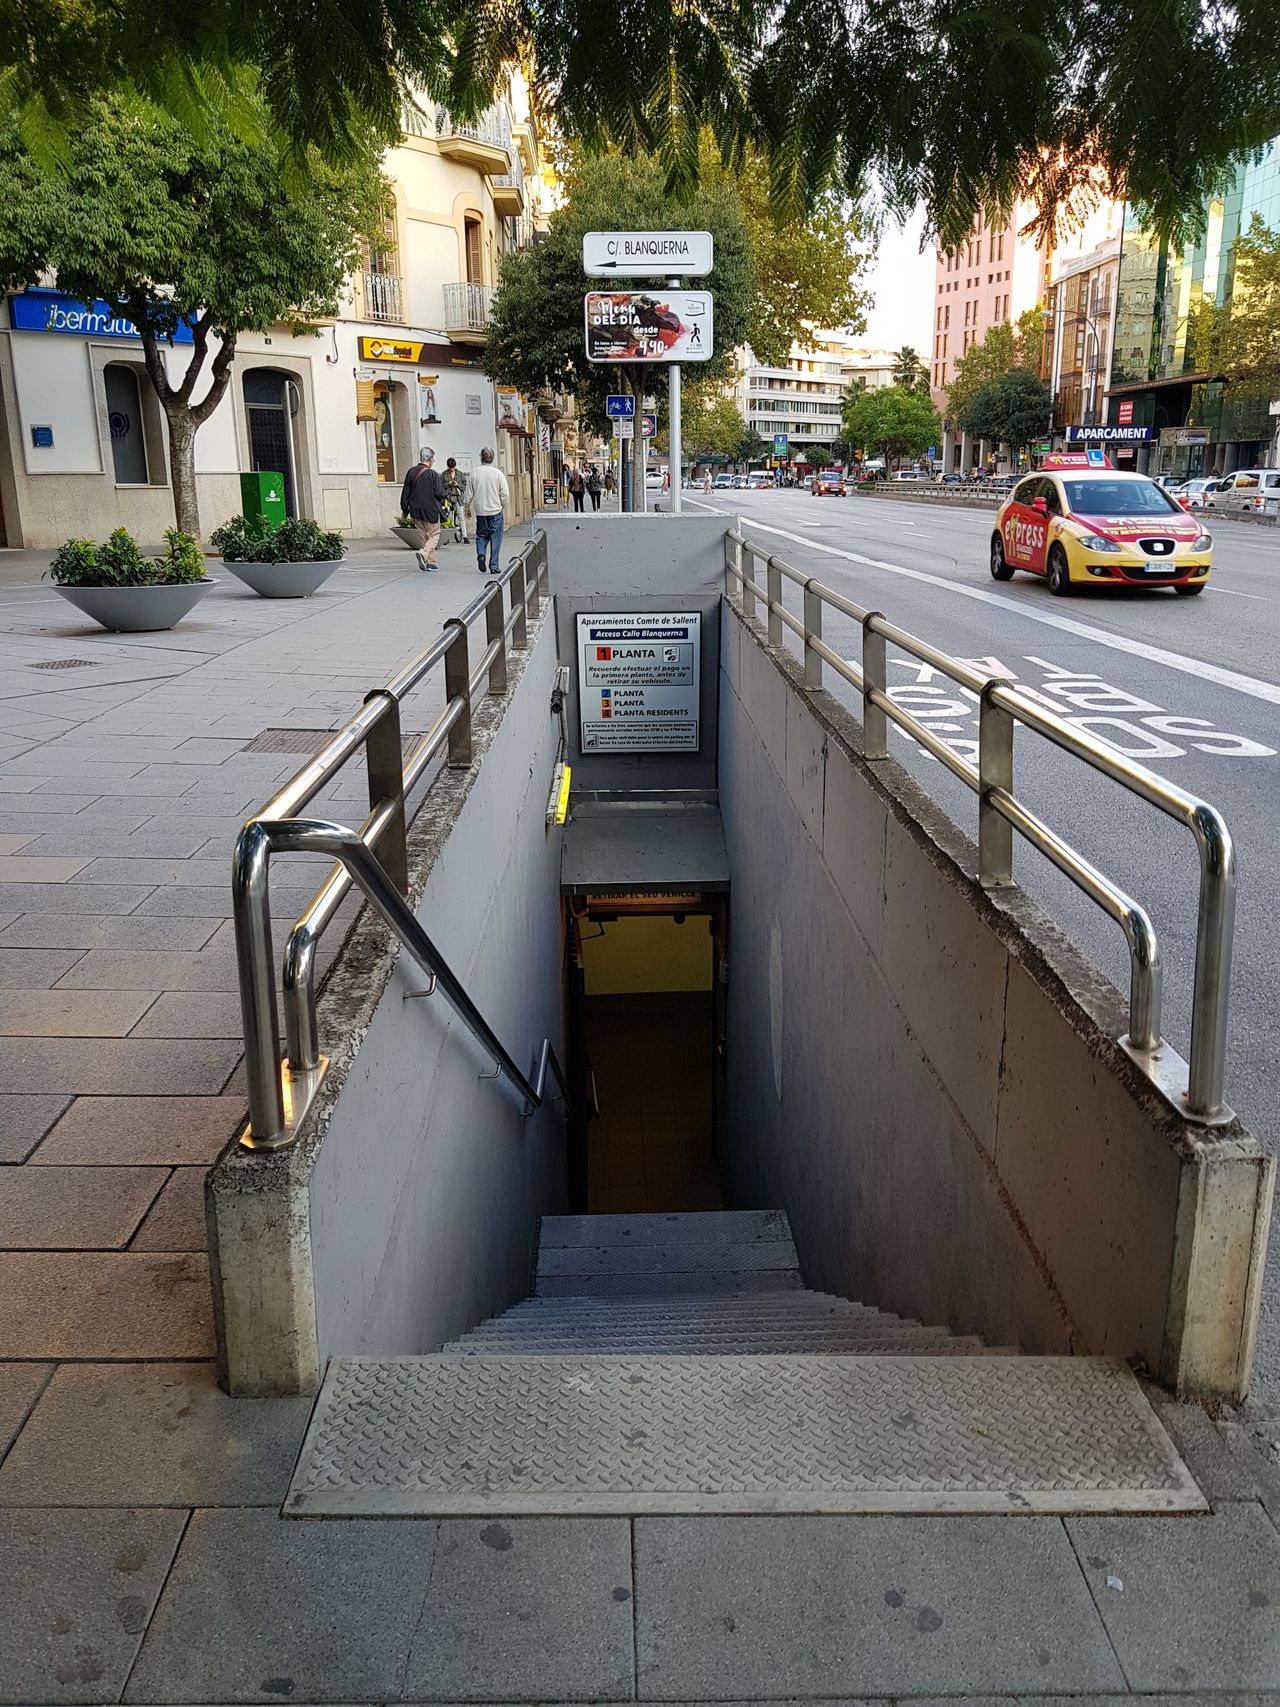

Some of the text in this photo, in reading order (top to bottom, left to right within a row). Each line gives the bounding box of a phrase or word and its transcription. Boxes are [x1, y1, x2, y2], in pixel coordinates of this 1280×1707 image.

[607, 240, 690, 256] C/. BLANQUERNA
[597, 301, 636, 316] Menú
[593, 314, 641, 325] DEL DÍA
[633, 326, 659, 334] desde
[1077, 428, 1148, 439] APARCAMENT
[1091, 452, 1100, 460] L
[581, 618, 635, 627] Aparcamientos
[672, 616, 698, 624] Sallent
[642, 630, 683, 638] Blanquerna
[600, 648, 656, 660] 1 PLANTA
[602, 689, 610, 698] 2
[602, 700, 610, 708] 3
[602, 710, 610, 718] 4
